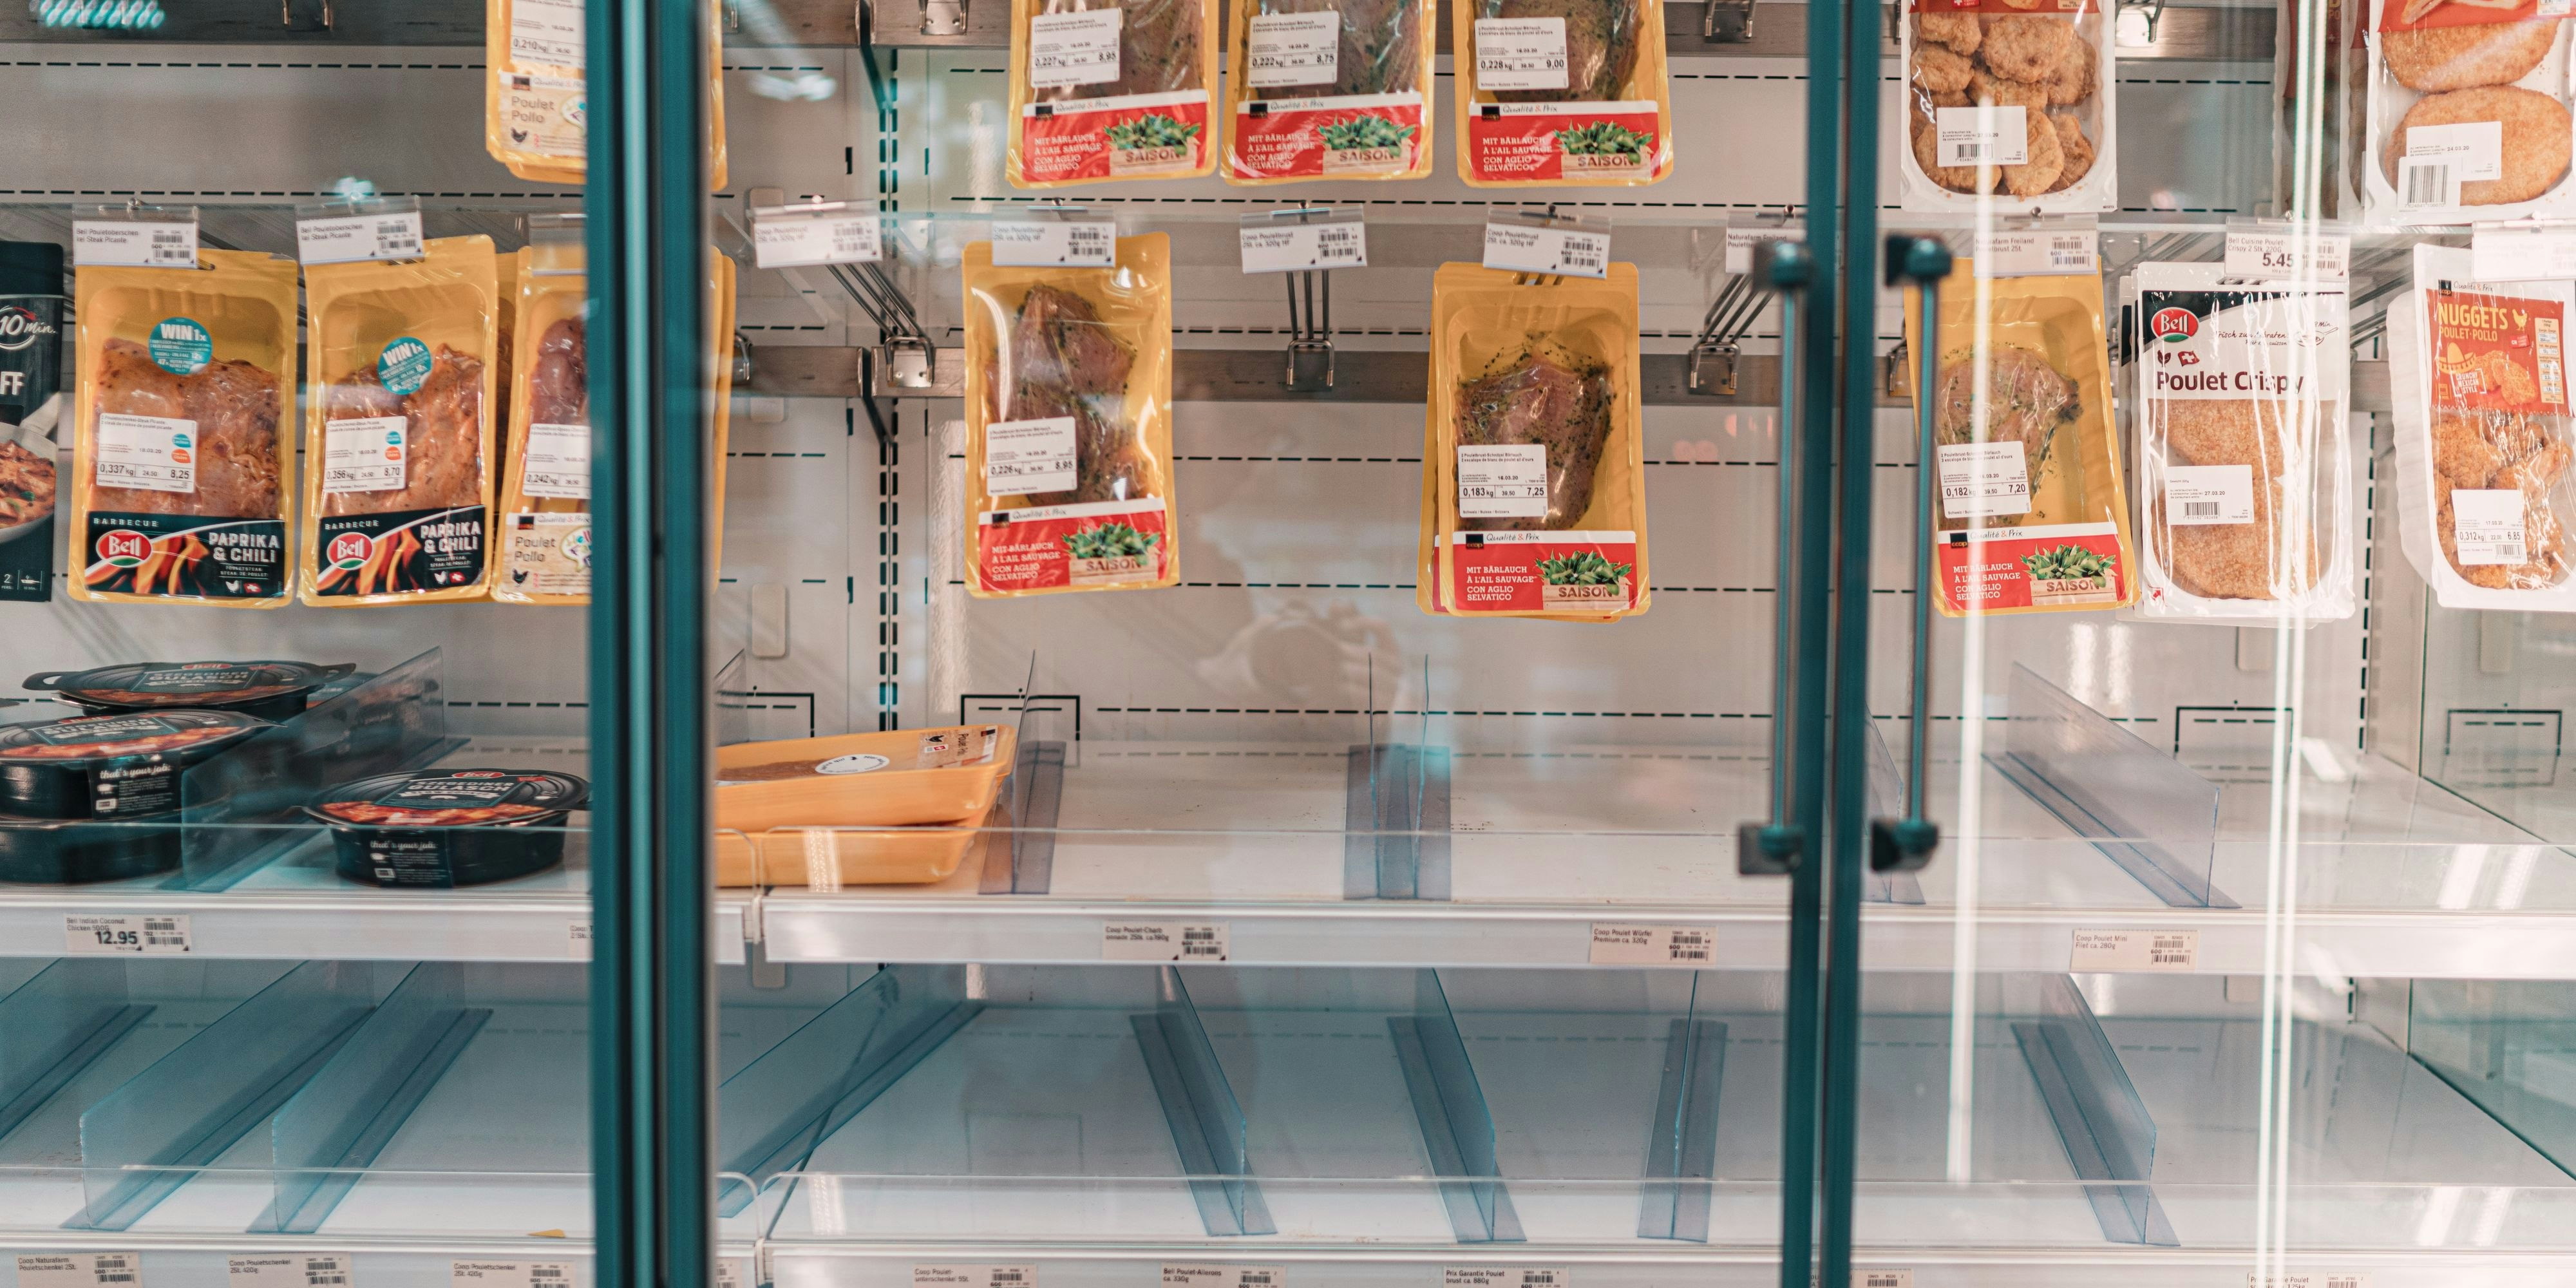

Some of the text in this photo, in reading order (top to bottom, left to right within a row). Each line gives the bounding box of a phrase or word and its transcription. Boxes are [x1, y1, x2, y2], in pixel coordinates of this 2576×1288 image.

[1481, 60, 1503, 71] 0,228
[1546, 59, 1564, 70] 9,00
[511, 95, 554, 110] Poulet
[1502, 104, 1534, 113] Qualité
[1542, 104, 1557, 113] Prix
[511, 110, 545, 123] Pollo
[1248, 133, 1309, 143] MIT BÄRLAUCH
[1500, 136, 1546, 145] BÄRLAUCH
[1578, 155, 1634, 167] SAISON
[1483, 164, 1530, 172] SELVATICO
[2262, 252, 2293, 267] 5.45
[2438, 303, 2508, 330] NUGGETS
[2161, 314, 2188, 334] Bell
[160, 323, 207, 342] WIN 1x
[2157, 371, 2304, 395] Poulet Crispy
[100, 464, 124, 473] 0,337
[171, 469, 189, 479] 8,25
[526, 474, 549, 484] 0,242
[1463, 488, 1485, 497] 0,183
[1527, 487, 1544, 497] 7,25
[1946, 487, 1968, 497] 0,182
[2009, 484, 2025, 494] 7,20
[93, 518, 159, 527] BARBECUE
[325, 520, 380, 530] BARBECUE
[420, 521, 482, 539] PAPRIKA
[209, 532, 280, 548] PAPRIKA
[515, 536, 555, 548] Poulet
[1486, 533, 1517, 542] Qualité
[1526, 533, 1540, 542] Prix
[2459, 531, 2477, 542] 0,312
[2508, 531, 2521, 541] 6,85
[108, 535, 141, 556] Bell
[337, 538, 364, 559] Bell
[424, 536, 478, 554] & CHILI
[213, 547, 276, 563] & CHILI
[515, 551, 545, 562] Pollo
[1483, 565, 1528, 574] BÄRLAUCH
[1970, 563, 2013, 572] BÄRLAUCH
[1466, 574, 1473, 583] À
[1475, 575, 1493, 583] L'AIL
[1558, 585, 1613, 598] SAISON
[2046, 580, 2100, 592] SAISON
[95, 931, 138, 944] 12.95
